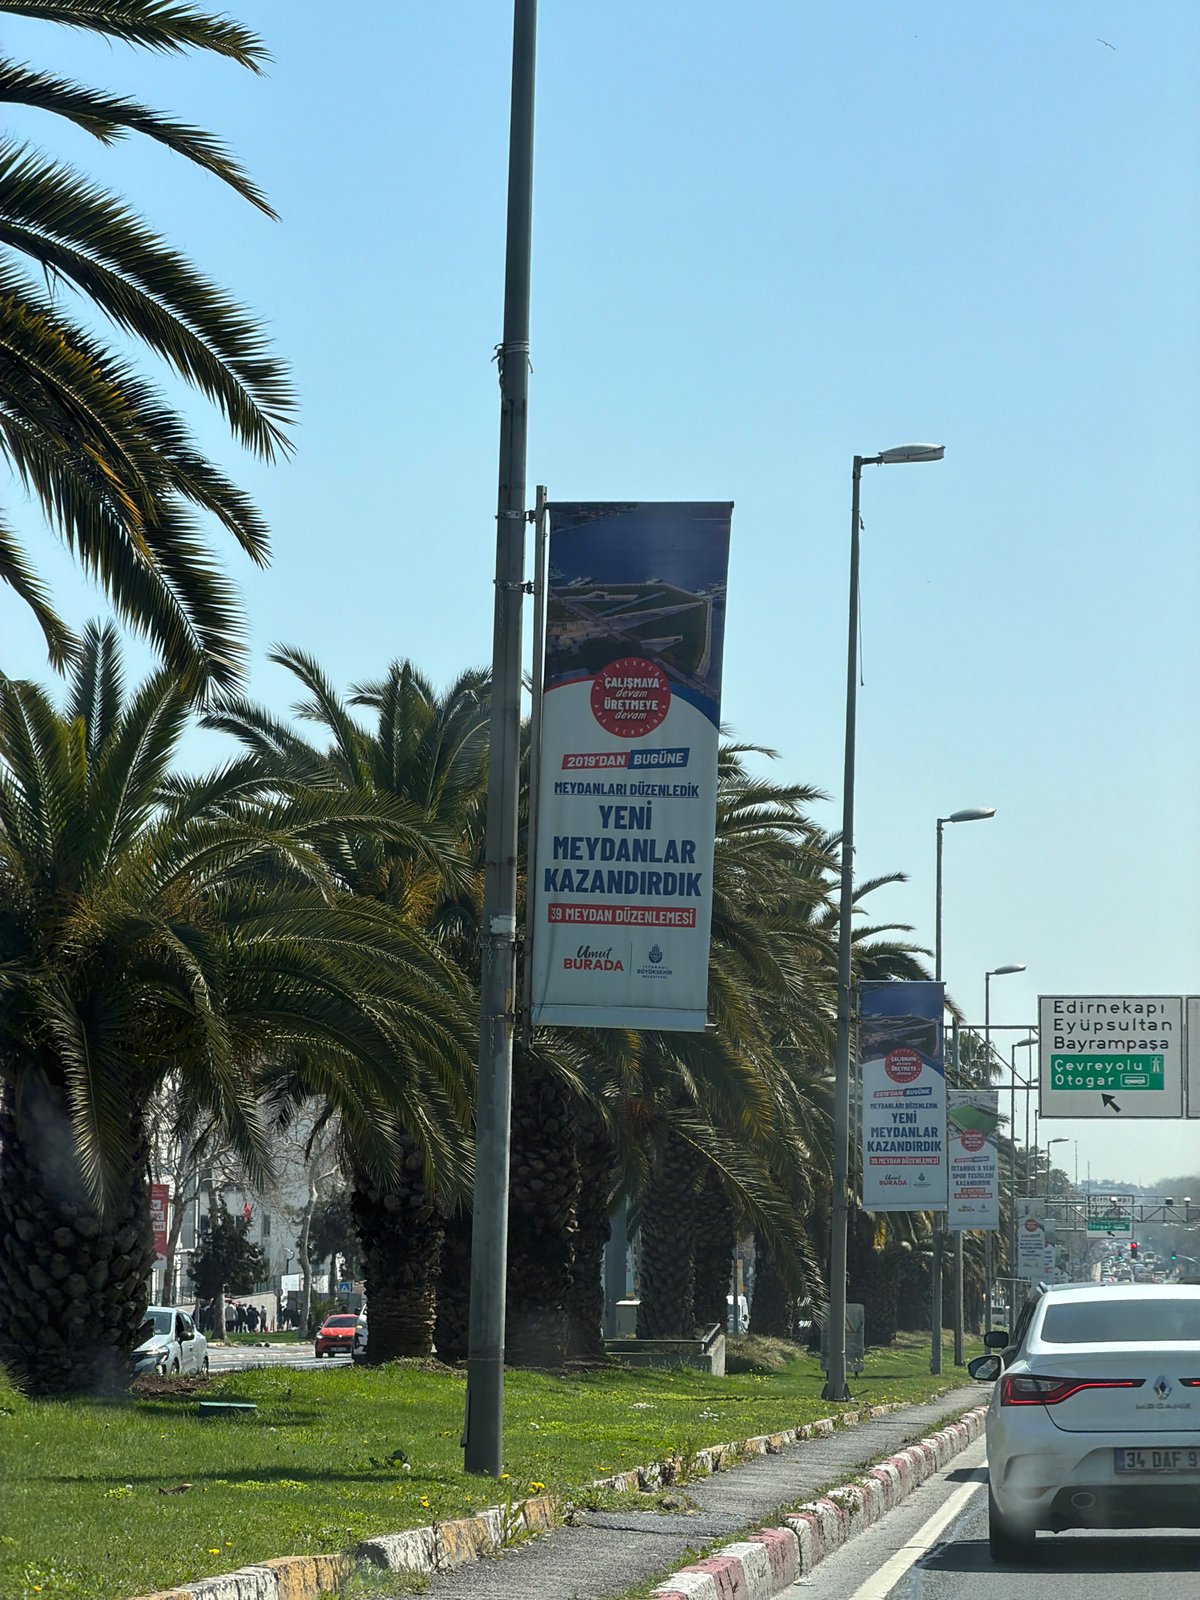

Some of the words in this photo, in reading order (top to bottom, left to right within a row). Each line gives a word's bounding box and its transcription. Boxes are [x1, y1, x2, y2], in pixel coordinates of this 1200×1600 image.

[604, 677, 660, 689] ÇALIŞMAYA
[615, 687, 648, 698] devam
[604, 696, 659, 710] ÜRETMEYE
[614, 708, 647, 719] devam
[633, 751, 685, 765] BUGÜNE
[554, 782, 627, 796] MEYDANLARI
[629, 781, 699, 797] DÜZENLEDİK
[599, 800, 653, 830] YENİ
[552, 836, 696, 864] MEYDANLAR
[544, 868, 703, 897] KAZANDIRDIK
[551, 908, 562, 920] 39
[565, 909, 613, 922] MEYDAN
[615, 907, 694, 925] DÜZENLEMESİ
[576, 945, 613, 960] Umut
[563, 958, 625, 972] BURADA
[1053, 1000, 1165, 1017] Edirnekapı
[1053, 1017, 1172, 1034] Eyüpsultan
[1053, 1036, 1169, 1053] Bayrampaşa
[1054, 1059, 1143, 1073] Çevreyolu
[1054, 1074, 1115, 1088] Otogar
[891, 1110, 917, 1124] YENİ
[870, 1127, 938, 1138] MEYDANLAR
[867, 1141, 942, 1152] KAZANDIRDIK
[1127, 1453, 1145, 1468] 34
[1152, 1452, 1181, 1468] DAF
